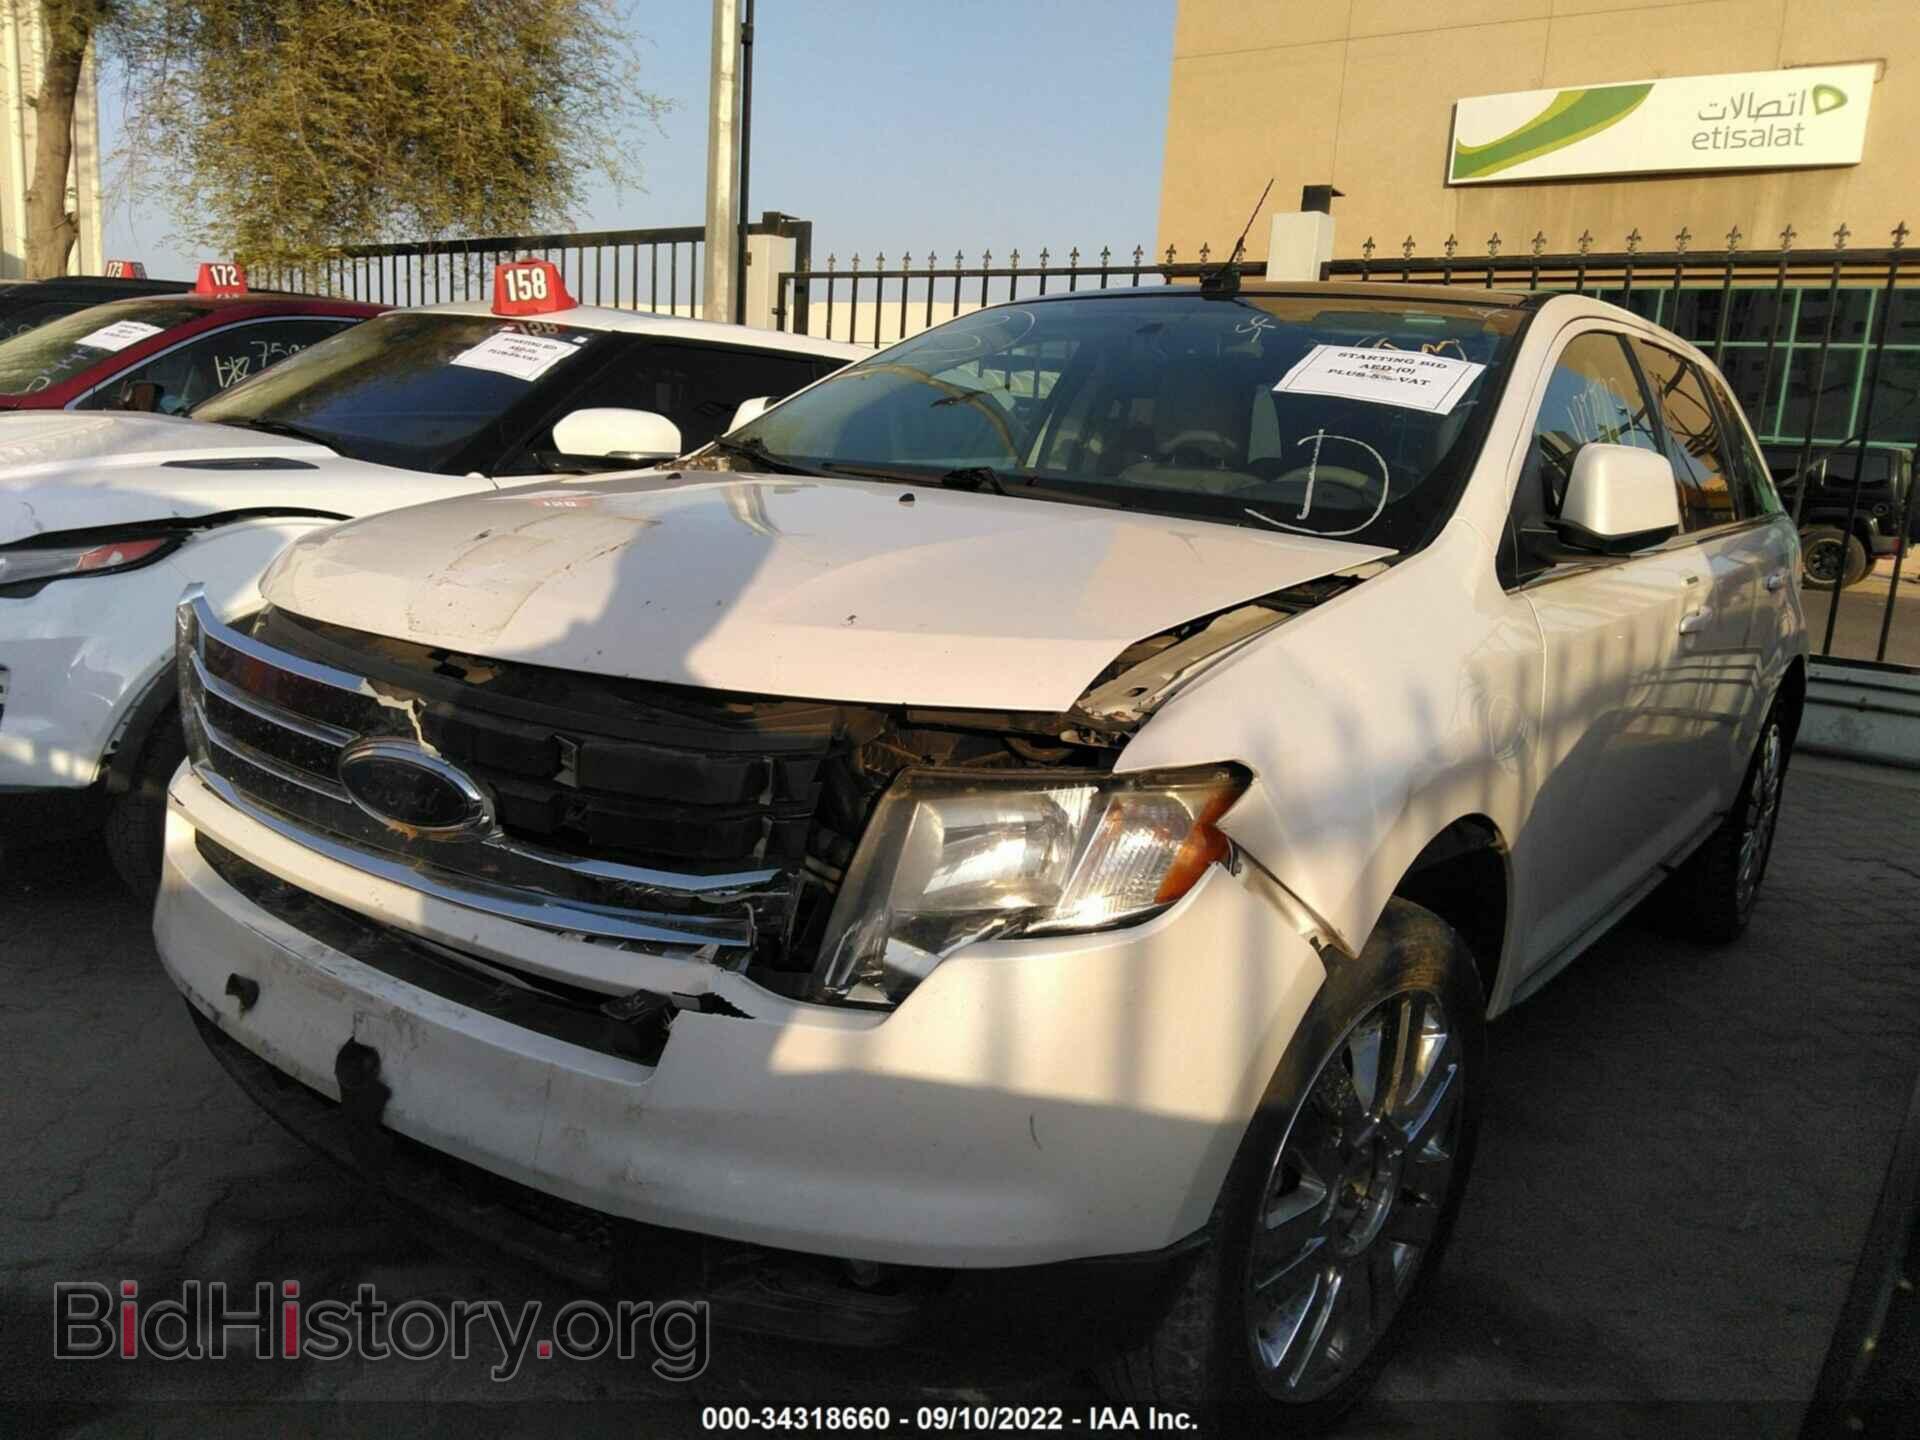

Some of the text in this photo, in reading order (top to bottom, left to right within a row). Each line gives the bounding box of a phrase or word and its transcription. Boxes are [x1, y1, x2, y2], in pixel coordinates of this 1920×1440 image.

[1698, 89, 1806, 122] اتصالات
[1692, 123, 1805, 150] etisalat
[107, 262, 123, 278] 173
[210, 265, 240, 286] 172
[505, 267, 547, 302] 158
[1337, 352, 1447, 369] STARTING BID
